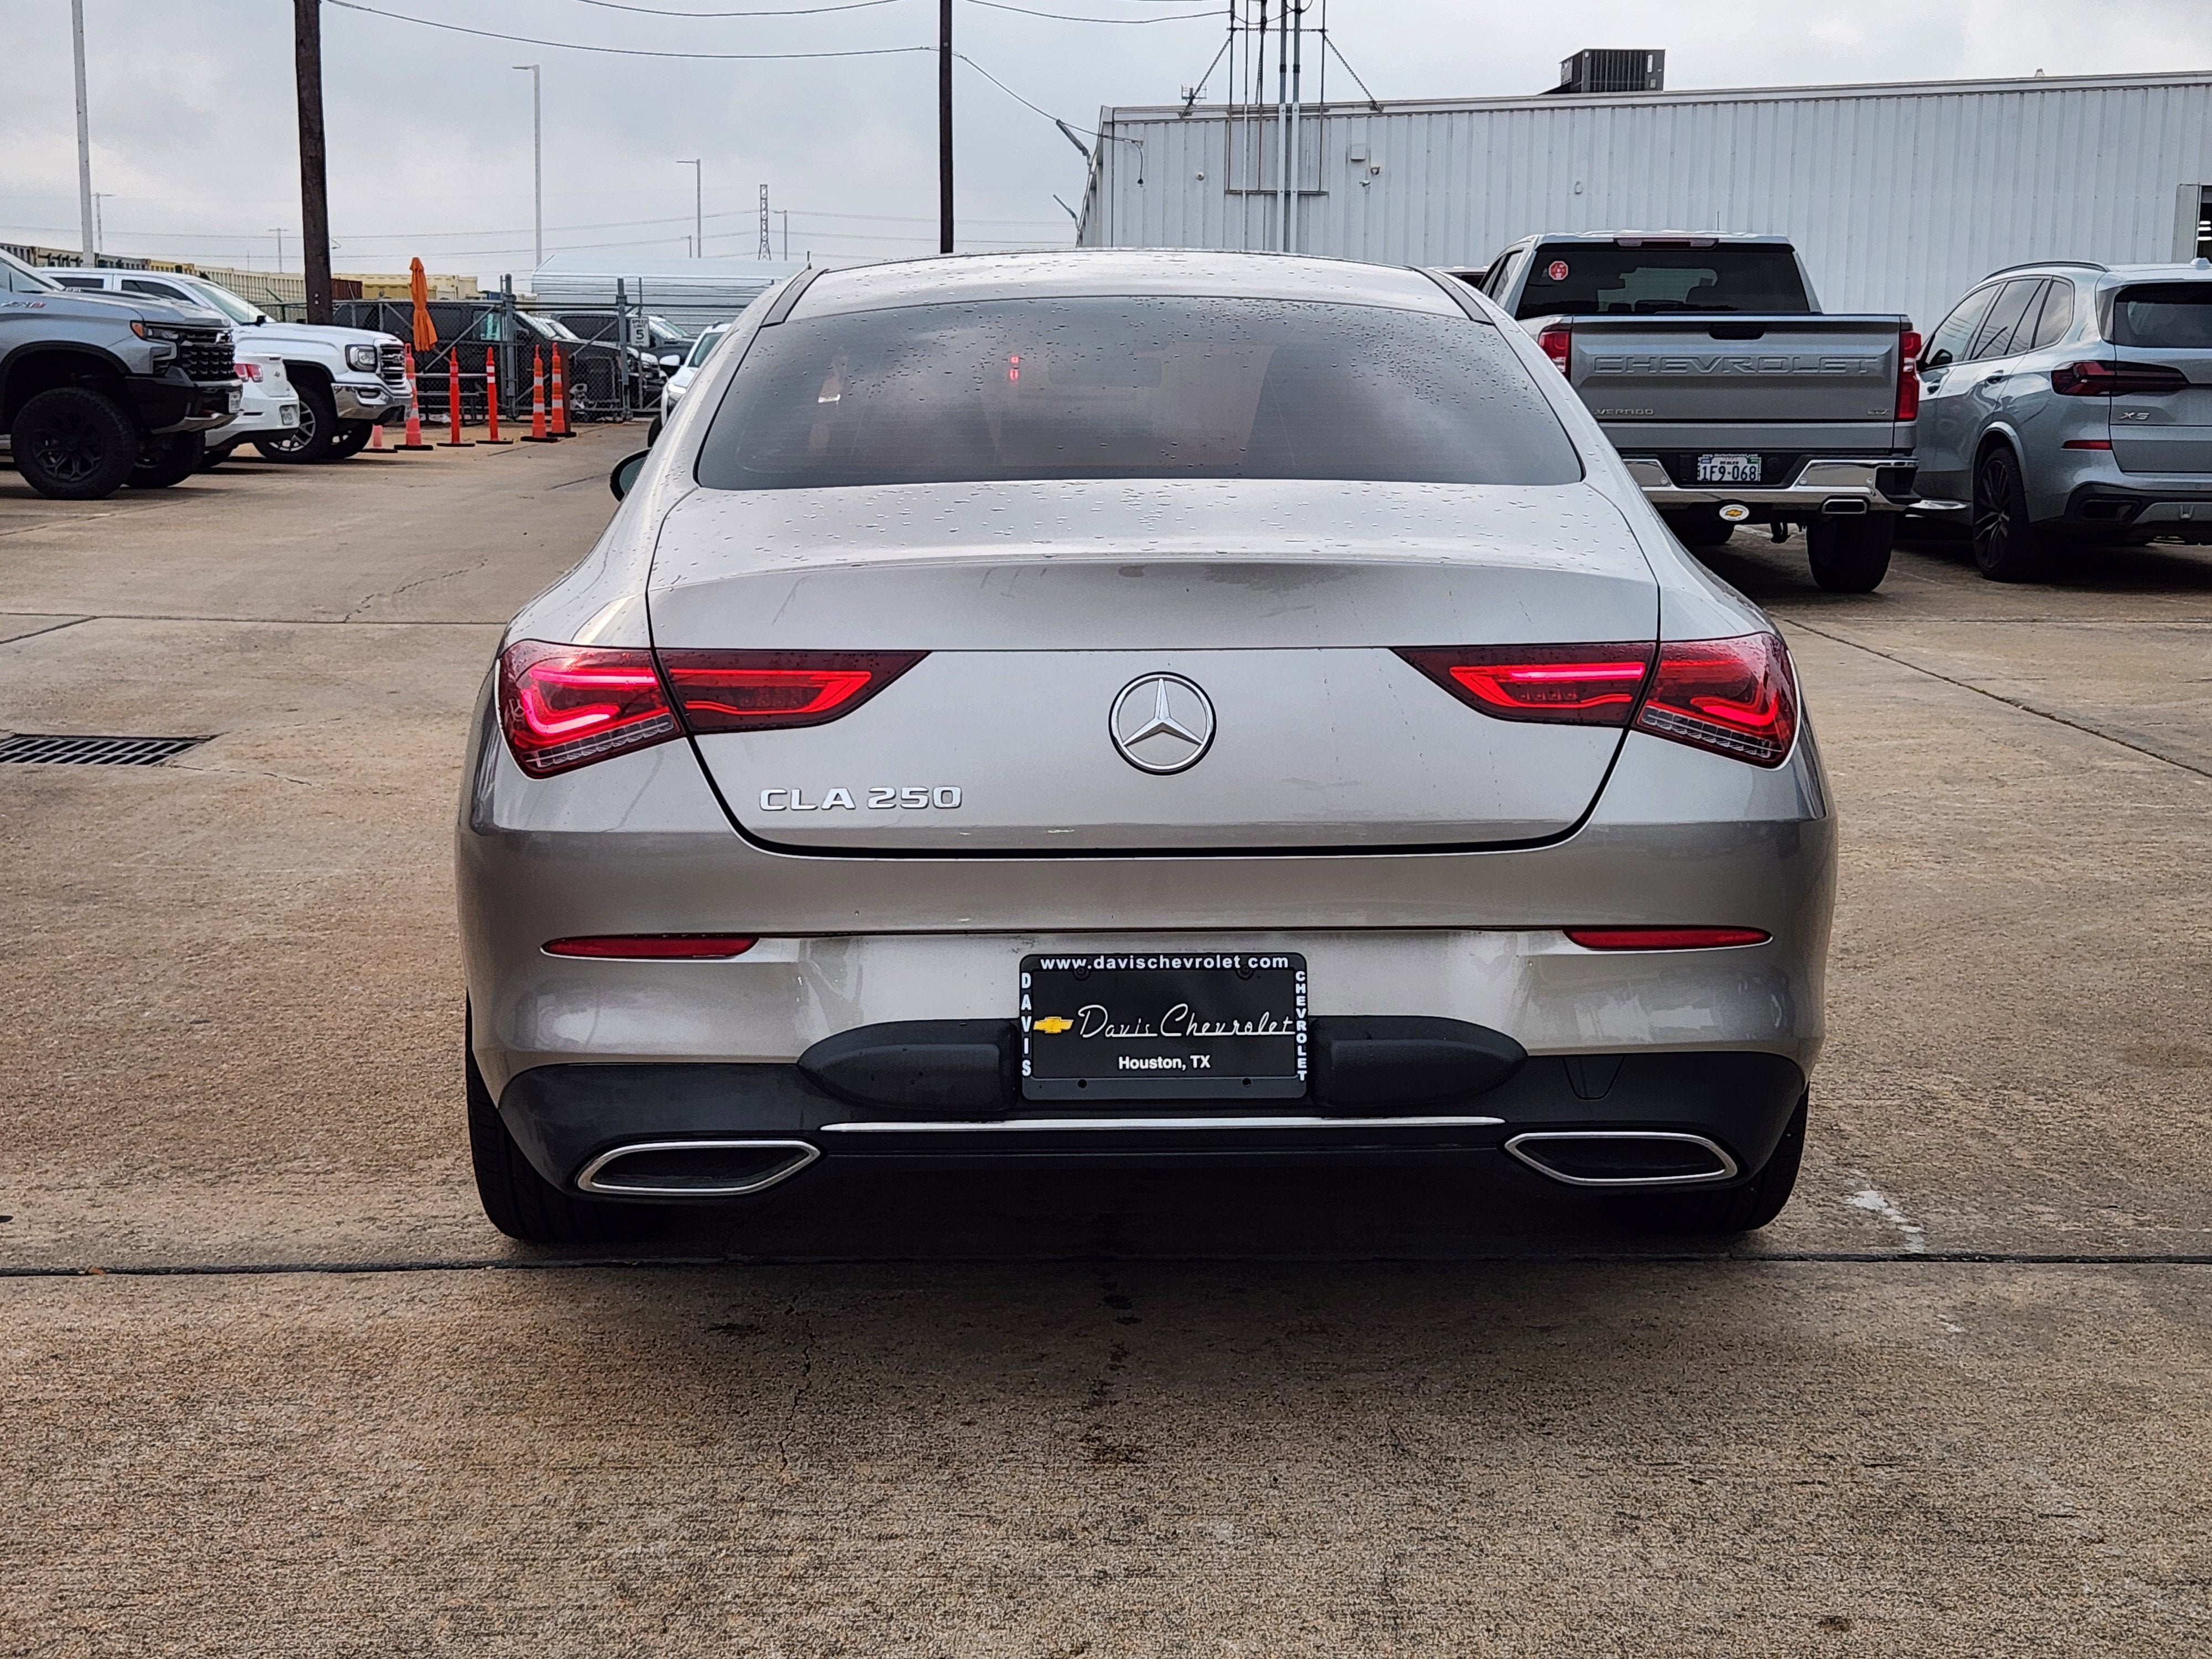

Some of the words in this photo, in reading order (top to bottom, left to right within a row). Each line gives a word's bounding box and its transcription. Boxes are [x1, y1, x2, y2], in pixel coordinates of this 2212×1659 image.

[637, 329, 644, 340] 5
[1594, 356, 1879, 373] CHEVROLET
[760, 788, 856, 810] CLA
[868, 786, 962, 809] 250
[1040, 954, 1288, 969] www.davischevroletcom
[1022, 973, 1031, 1077] DAVIS
[1077, 1005, 1158, 1038] Davis
[1160, 1003, 1296, 1036] Chevrolet
[1295, 971, 1307, 1081] CHEVROLET
[1118, 1056, 1186, 1071] Houston,
[1190, 1056, 1211, 1068] TX
